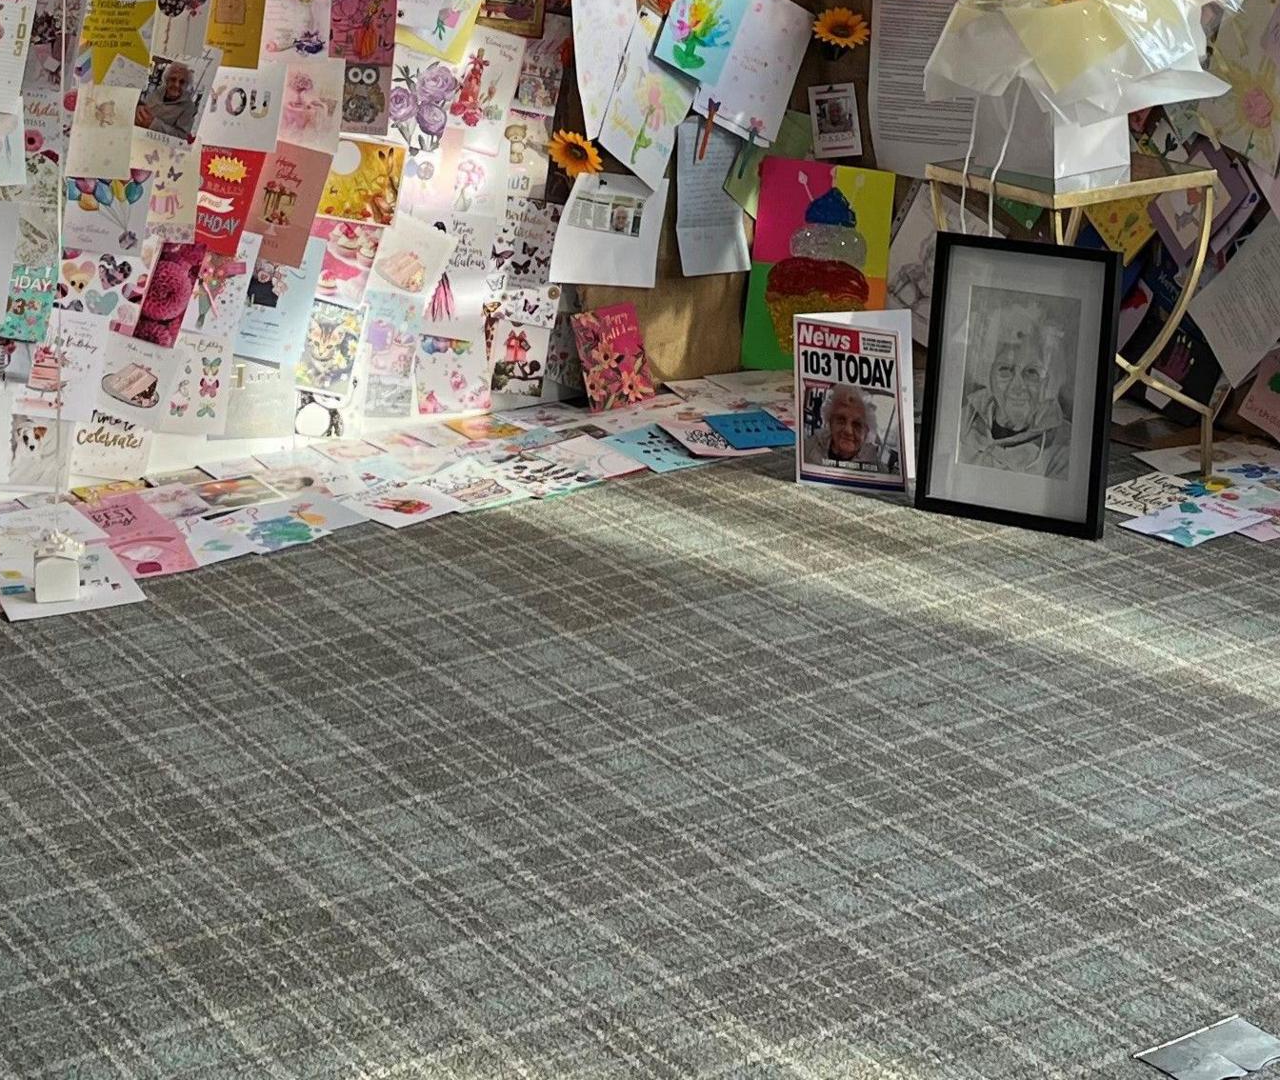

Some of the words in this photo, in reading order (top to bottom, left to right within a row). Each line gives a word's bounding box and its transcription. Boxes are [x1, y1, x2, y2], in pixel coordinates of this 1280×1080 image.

[94, 63, 120, 102] 103
[208, 83, 272, 120] YOU
[799, 323, 852, 351] News
[801, 349, 832, 377] 103
[833, 351, 896, 389] TODAY
[75, 426, 144, 450] Celebrate!
